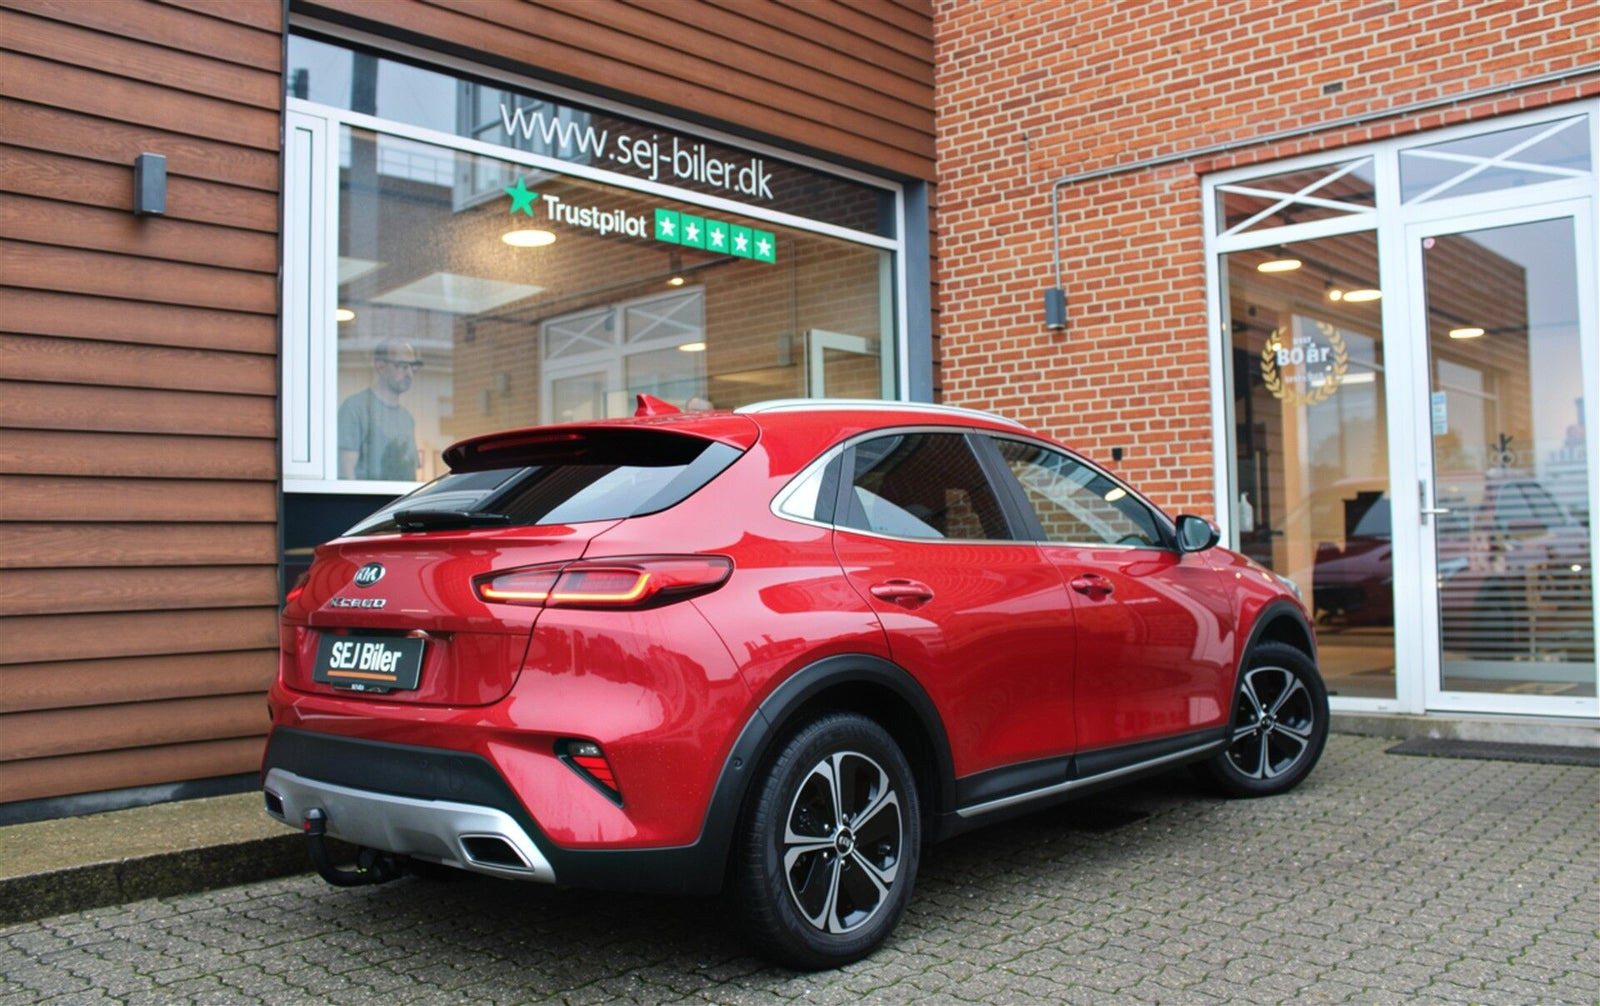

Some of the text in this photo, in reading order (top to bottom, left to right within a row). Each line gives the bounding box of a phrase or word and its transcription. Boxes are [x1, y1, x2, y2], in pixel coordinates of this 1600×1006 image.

[500, 103, 774, 200] www.sej-biler.dk
[542, 194, 648, 239] Trustpilot
[329, 641, 402, 672] SEJ Biler
